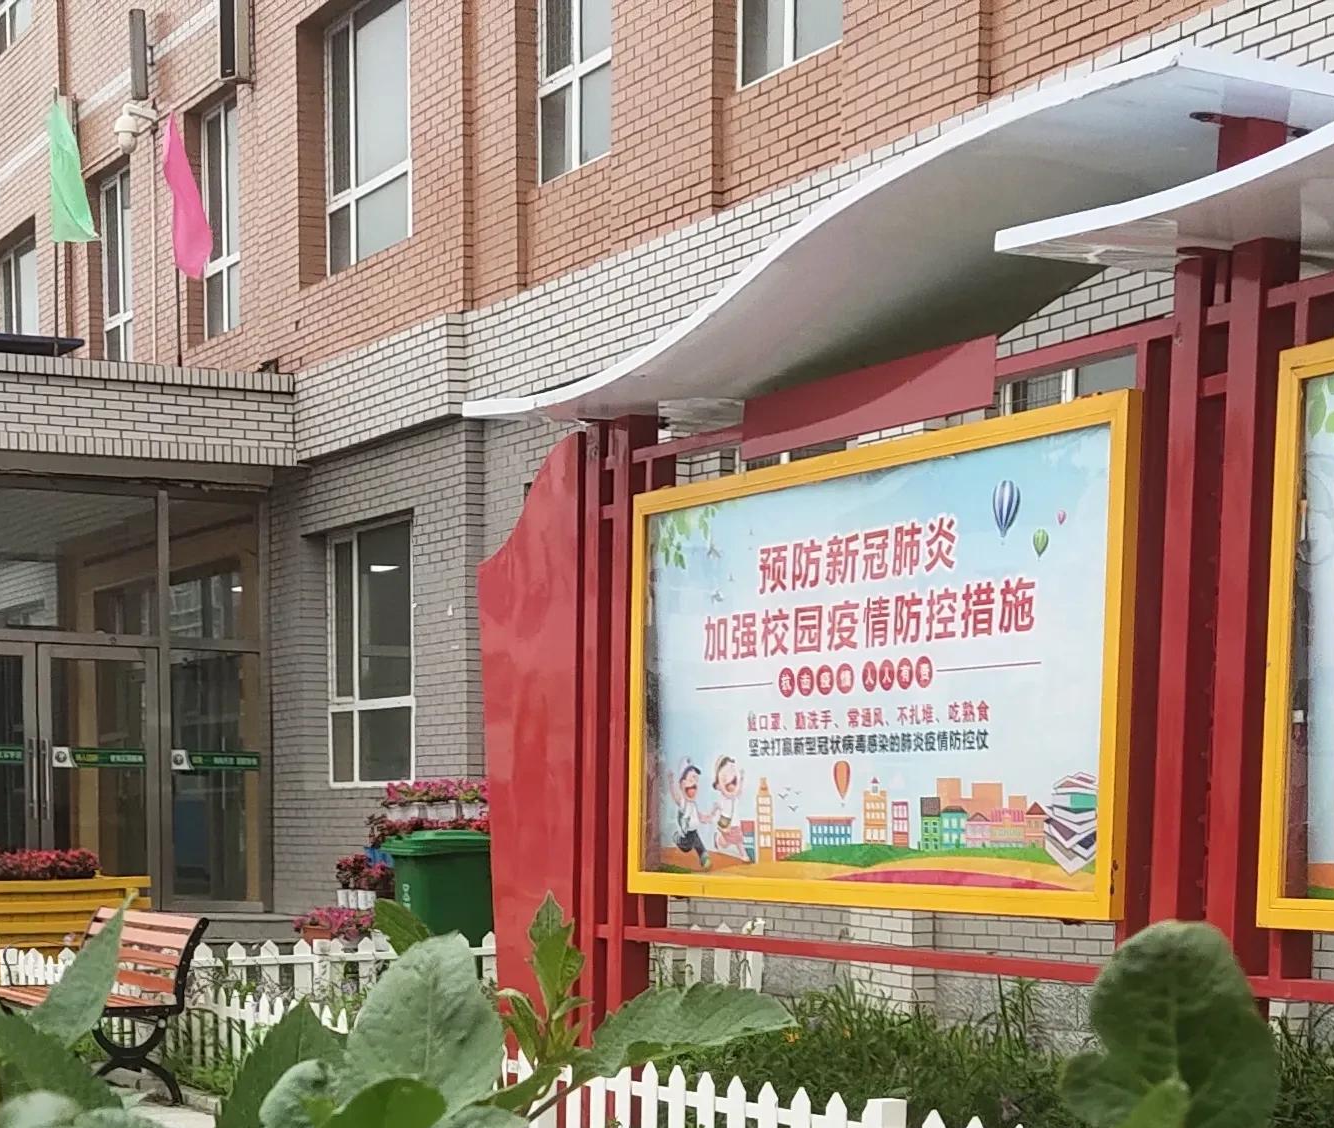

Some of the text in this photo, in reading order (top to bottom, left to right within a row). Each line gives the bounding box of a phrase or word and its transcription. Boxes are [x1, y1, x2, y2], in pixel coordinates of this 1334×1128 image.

[758, 514, 958, 595] 预防新冠肺炎
[703, 578, 1036, 662] 加强校园疫情防控措施
[748, 728, 990, 757] 坚决打赢新型冠状病毒感染的肺炎疫情防控仗
